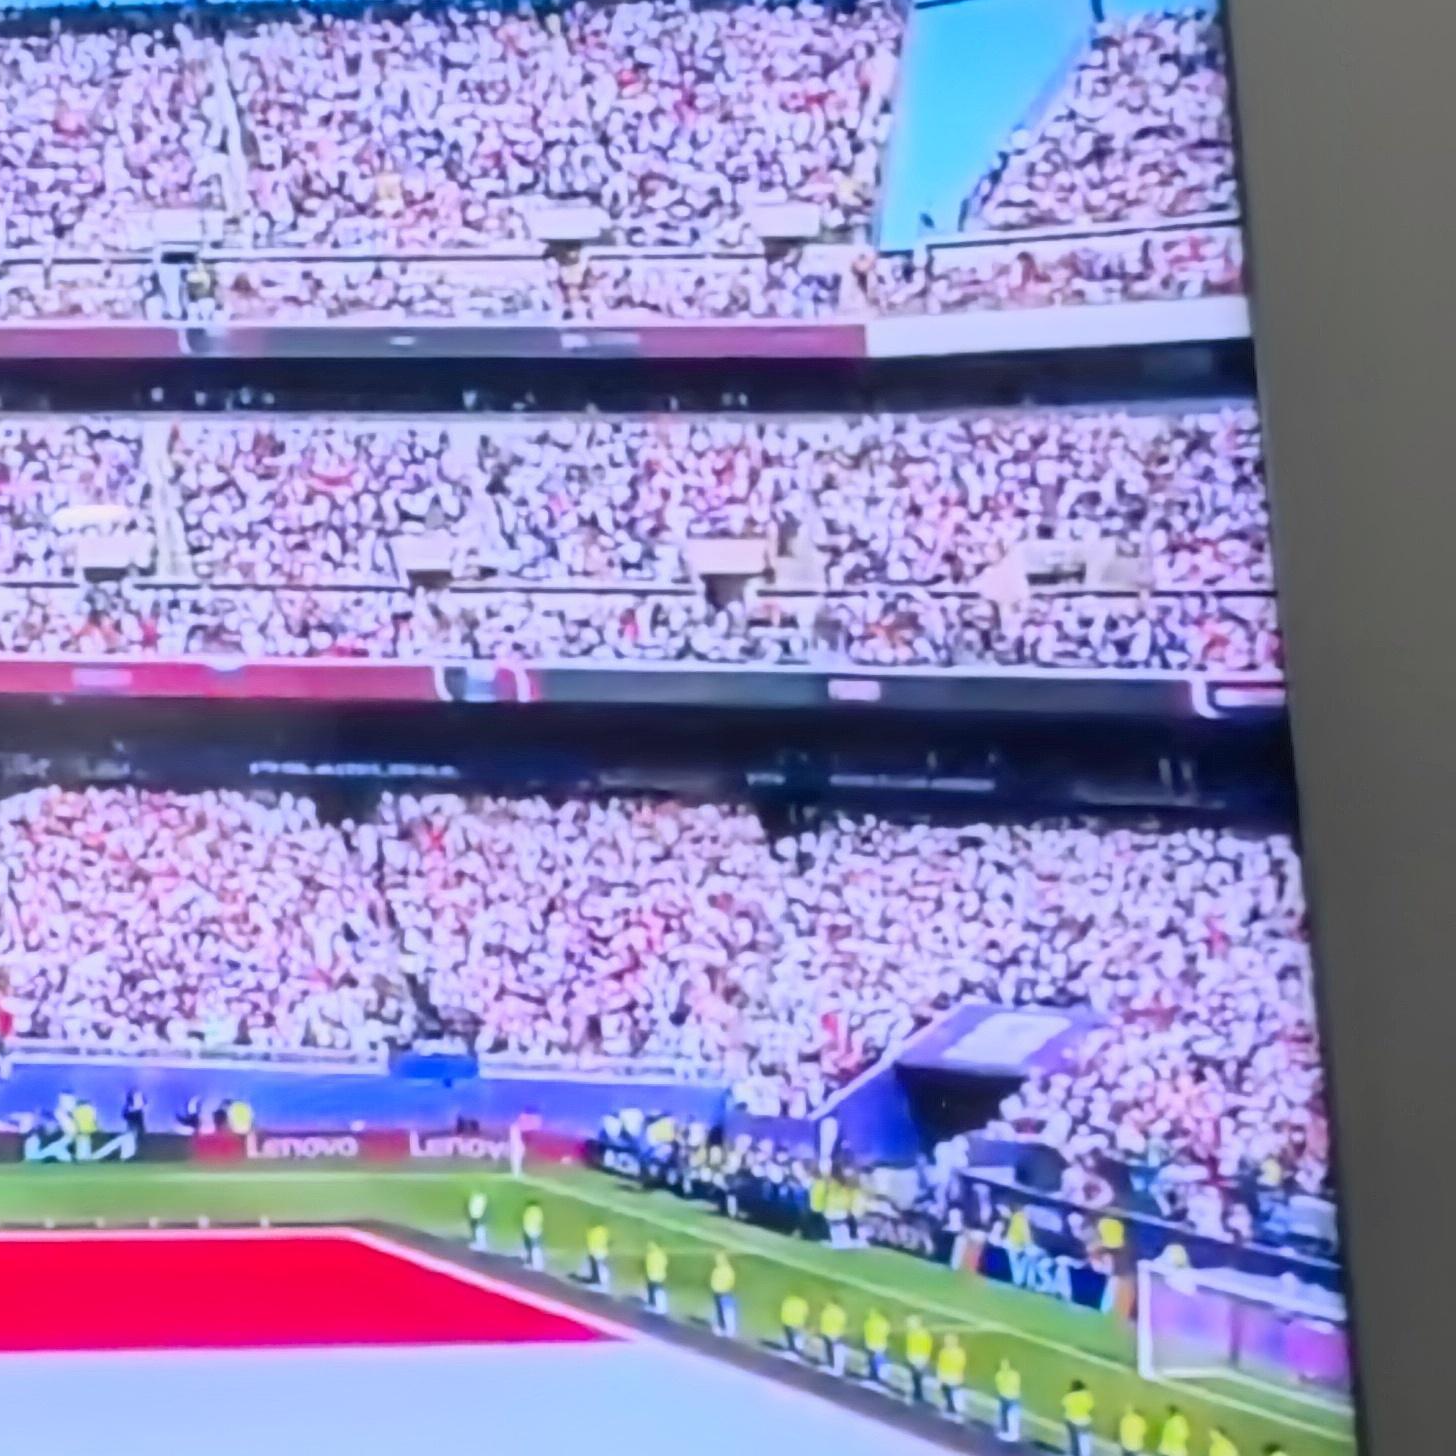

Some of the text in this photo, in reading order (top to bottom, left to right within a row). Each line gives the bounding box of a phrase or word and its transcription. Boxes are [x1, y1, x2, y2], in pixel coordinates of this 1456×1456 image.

[247, 1131, 358, 1159] Lenovo
[409, 1130, 524, 1161] Lenov
[1006, 1244, 1073, 1302] VISA
